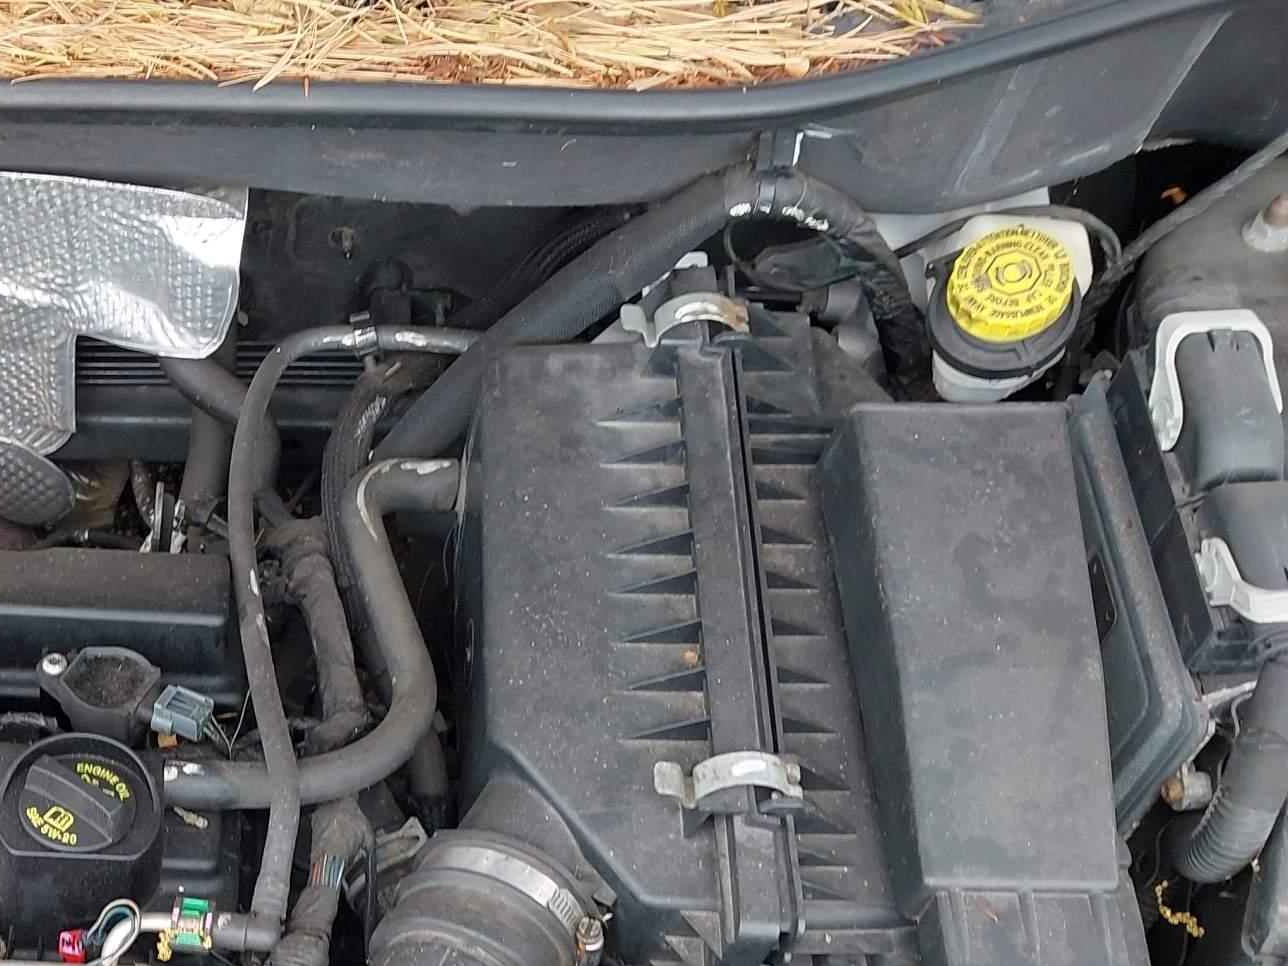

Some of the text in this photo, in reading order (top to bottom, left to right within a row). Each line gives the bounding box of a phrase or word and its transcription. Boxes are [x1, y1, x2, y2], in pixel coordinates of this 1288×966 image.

[77, 762, 130, 801] ENGINE OIL
[26, 806, 45, 829] SAE
